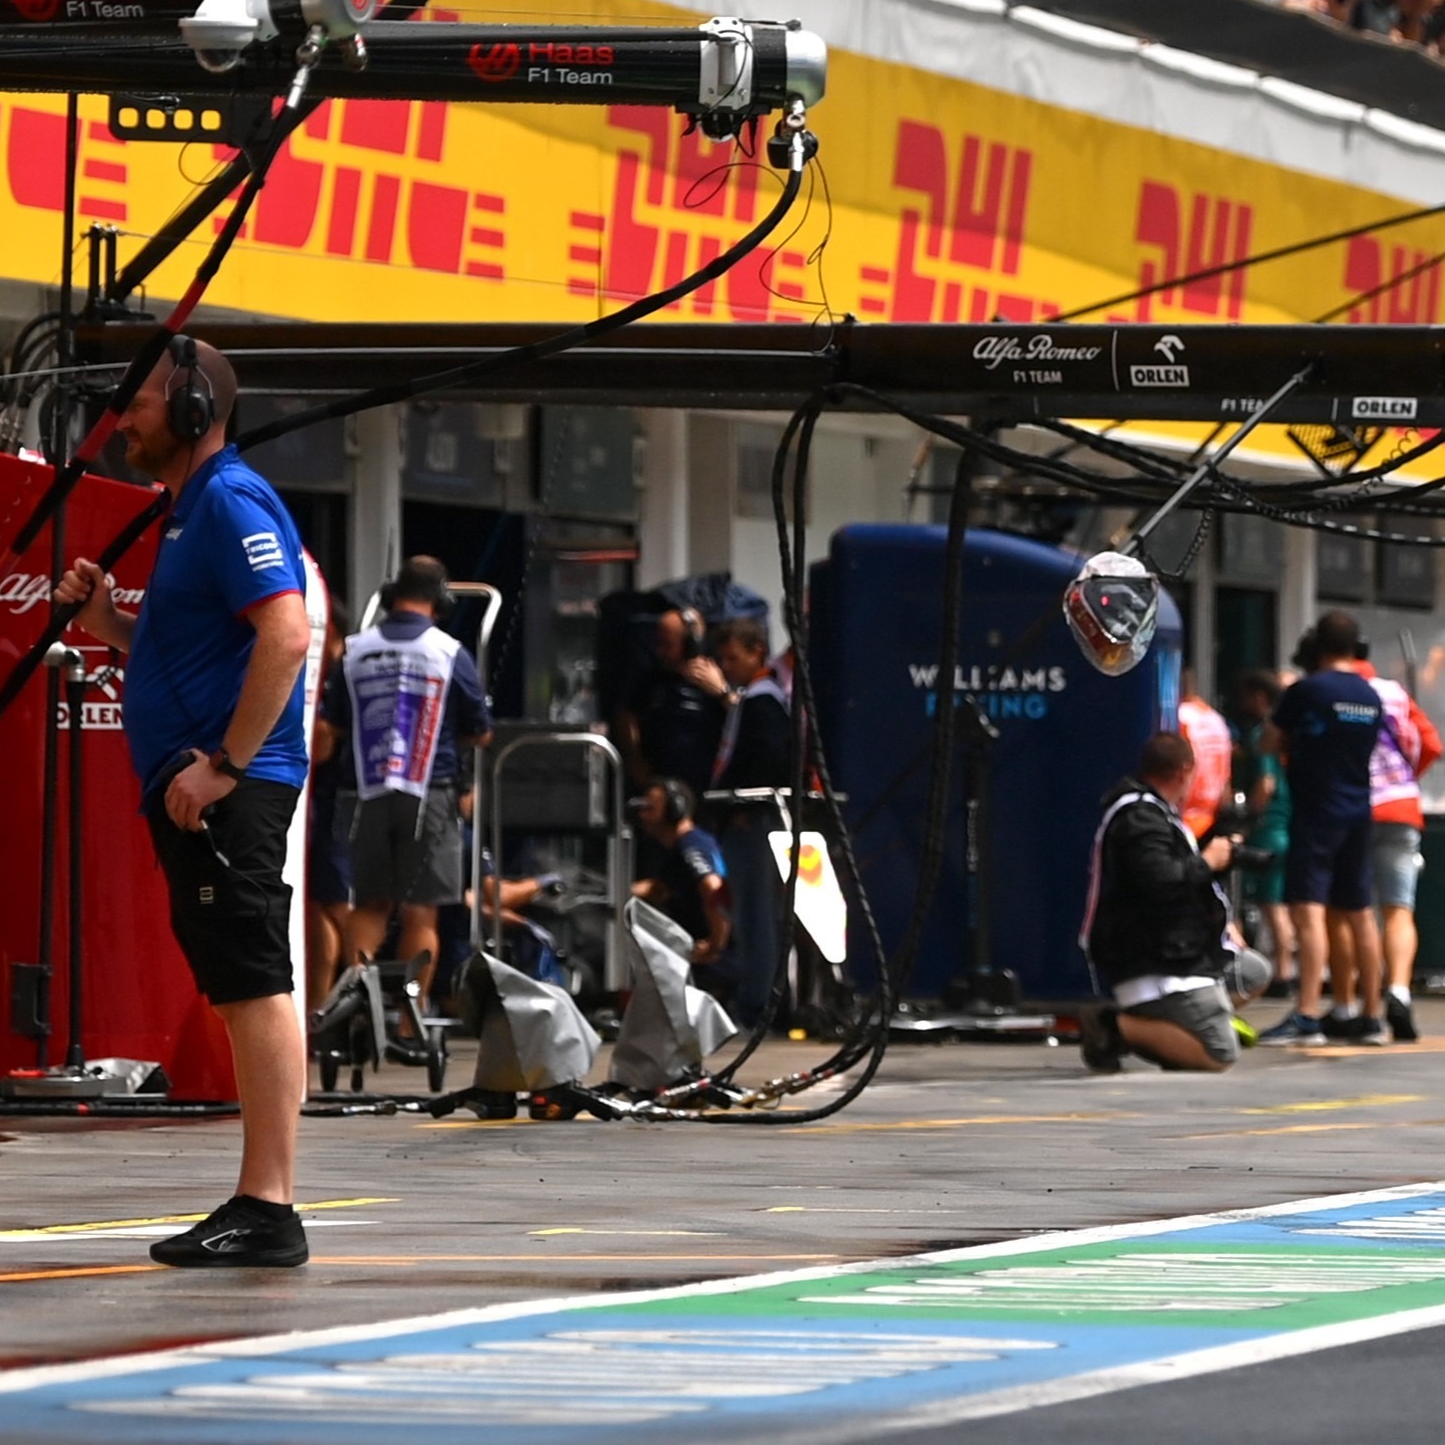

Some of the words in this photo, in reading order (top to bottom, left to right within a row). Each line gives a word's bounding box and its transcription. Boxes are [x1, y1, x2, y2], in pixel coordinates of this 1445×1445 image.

[66, 1, 87, 17] F1
[90, 1, 144, 17] Team
[528, 42, 615, 66] Haas
[527, 67, 549, 83] F1
[555, 68, 613, 85] Team
[973, 336, 1023, 370] Alfa
[1022, 334, 1102, 360] Romeo
[1013, 370, 1027, 383] F1
[1029, 370, 1063, 384] TEAM
[1134, 369, 1185, 384] ORLEN
[1356, 400, 1413, 416] ORLEN
[908, 664, 1067, 692] WLLAMS
[57, 708, 123, 724] OLEN
